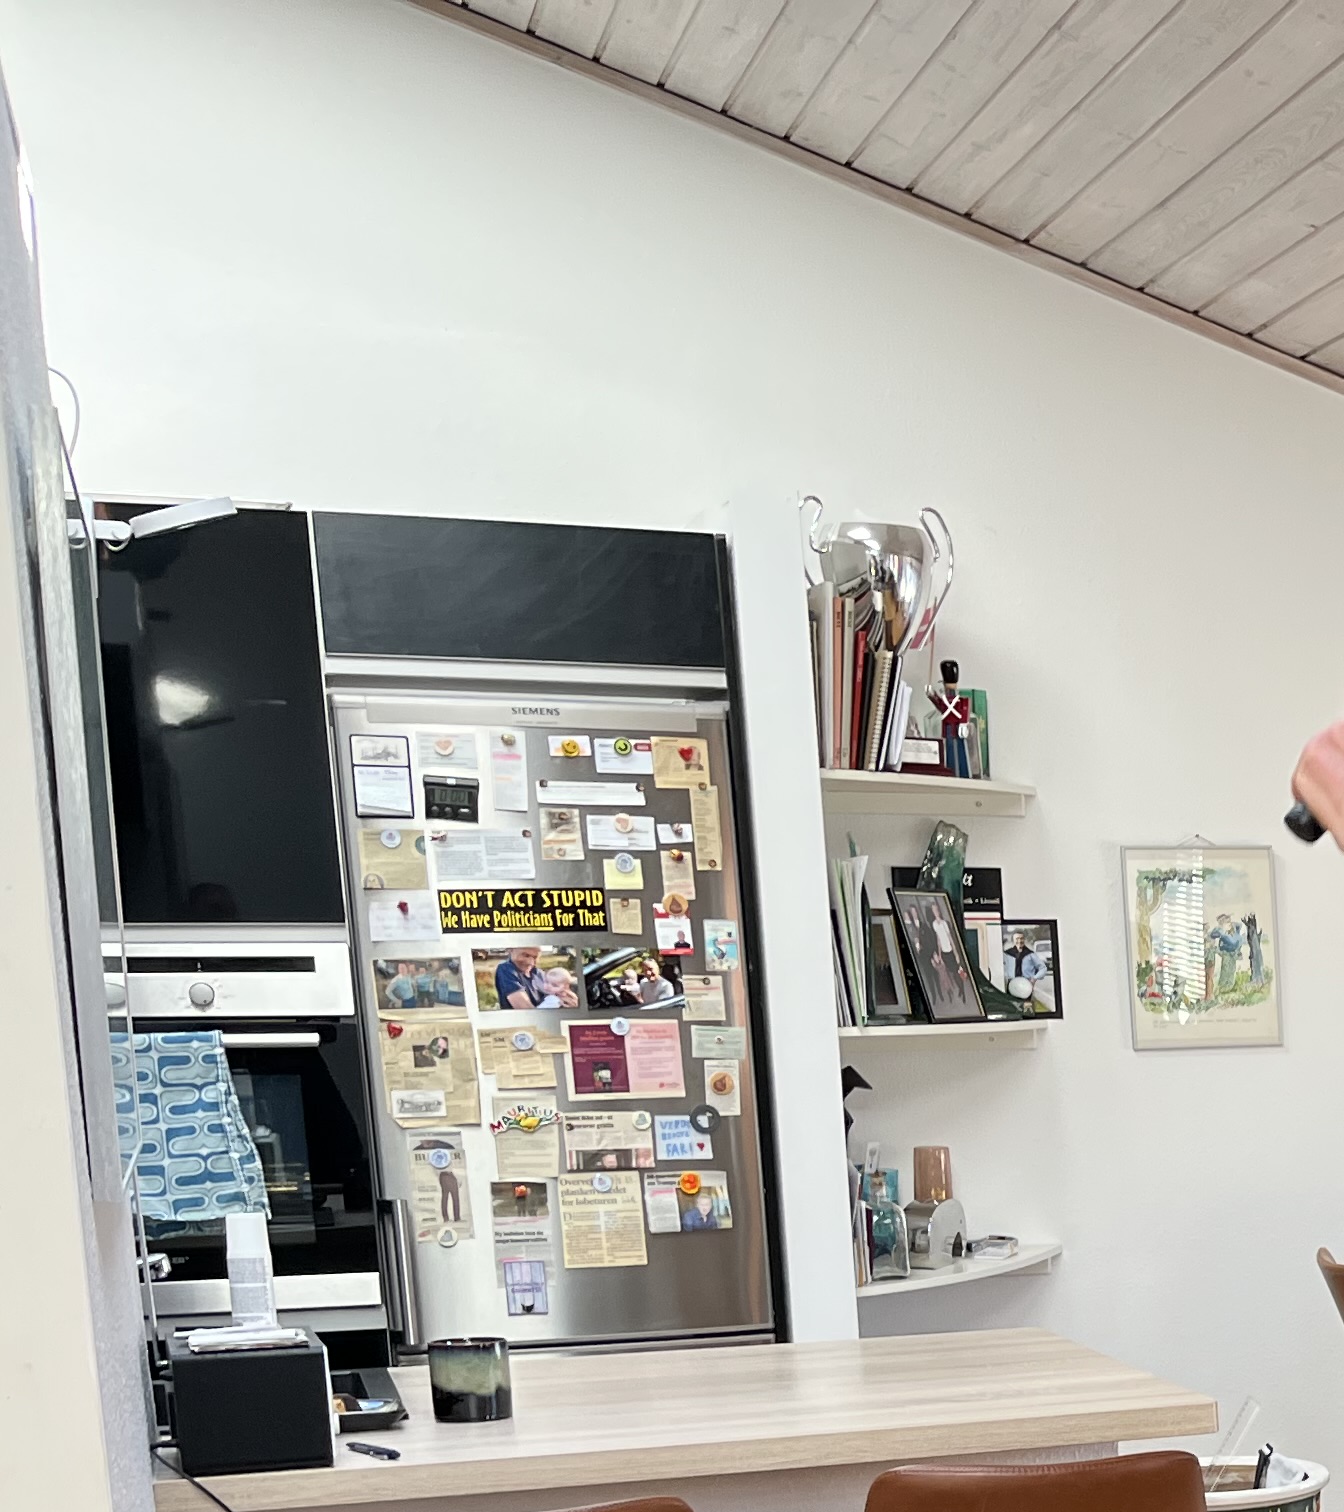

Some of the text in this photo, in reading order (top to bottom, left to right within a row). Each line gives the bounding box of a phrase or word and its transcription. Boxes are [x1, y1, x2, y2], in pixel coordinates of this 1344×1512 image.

[511, 707, 560, 716] SIEMENS
[440, 890, 603, 909] DON'T ACT STUPID
[441, 909, 606, 929] We Have Politicians For That
[489, 1105, 561, 1133] MAURITIUS
